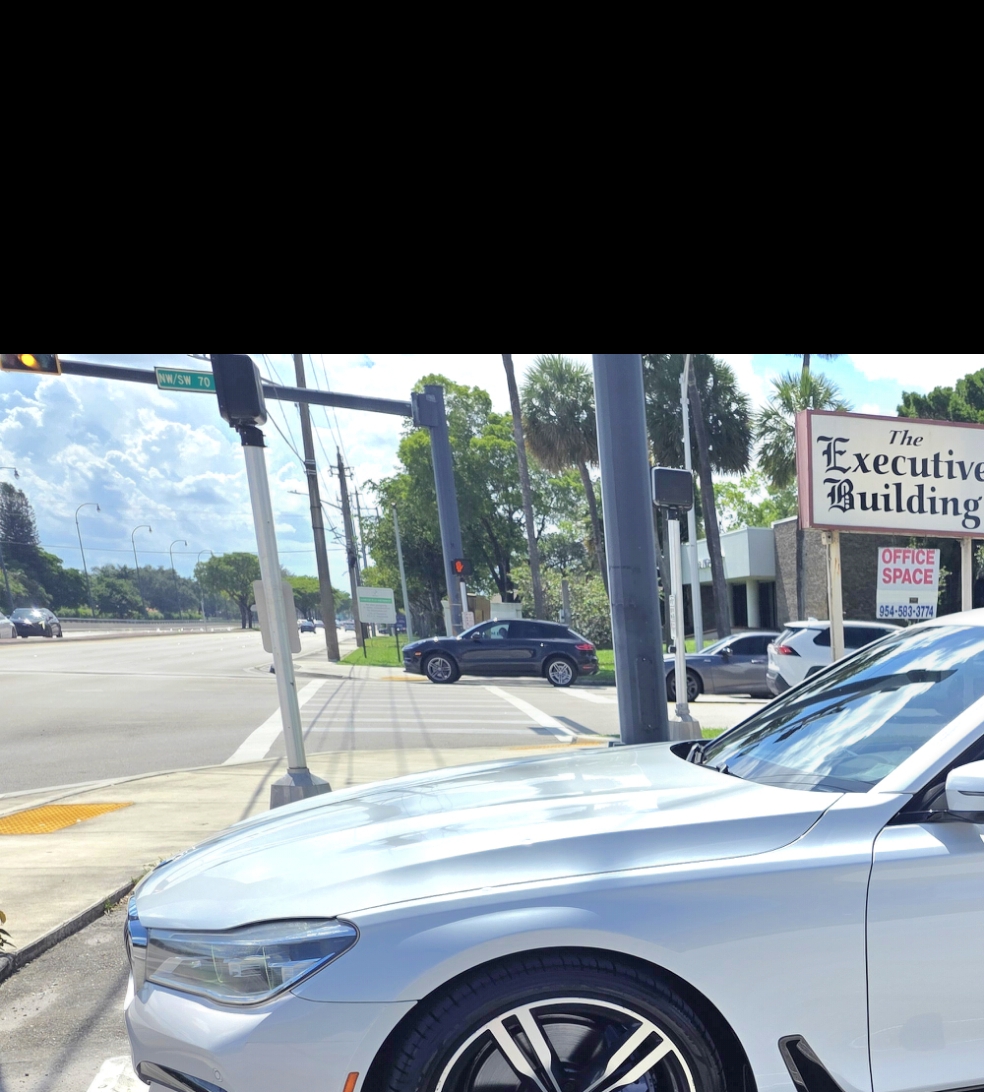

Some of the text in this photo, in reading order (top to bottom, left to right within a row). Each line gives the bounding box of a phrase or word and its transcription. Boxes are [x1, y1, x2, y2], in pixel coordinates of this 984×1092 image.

[158, 373, 211, 388] NW/SW 70
[888, 429, 924, 447] The
[823, 477, 983, 530] Building
[881, 547, 936, 565] OFFICE
[881, 567, 934, 585] SPACE
